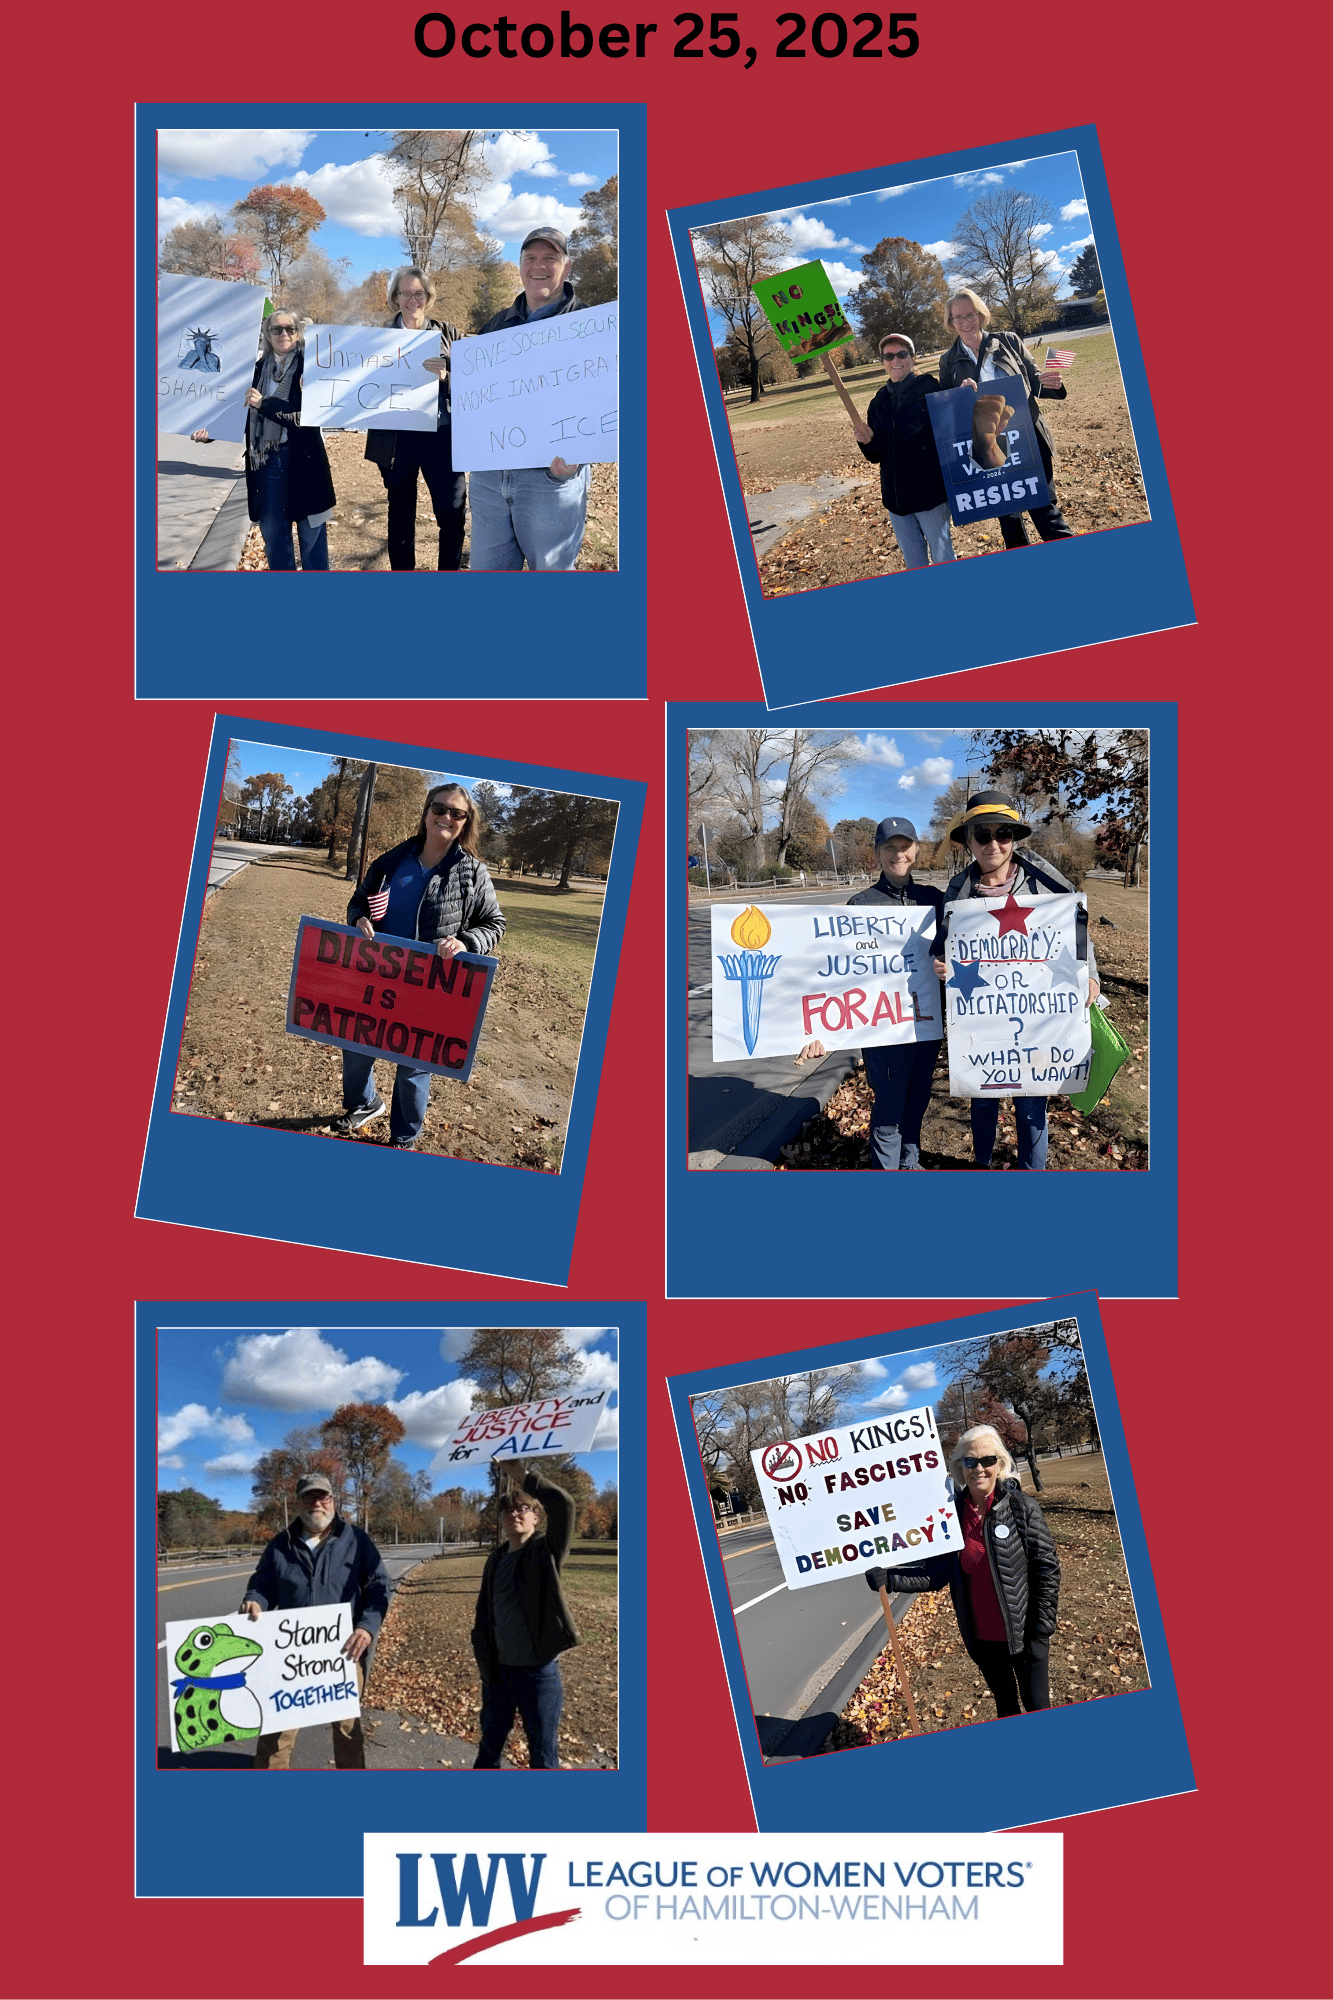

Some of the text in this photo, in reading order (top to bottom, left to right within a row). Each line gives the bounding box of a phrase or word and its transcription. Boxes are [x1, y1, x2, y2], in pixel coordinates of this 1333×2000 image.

[771, 284, 804, 309] NO
[775, 302, 842, 336] KINGS!
[463, 339, 507, 376] SAVE
[511, 326, 567, 356] SOCIAL
[319, 378, 412, 411] ICE
[457, 381, 502, 415] MORE
[490, 410, 618, 453] NO ICE
[955, 476, 1039, 513] RESIST
[813, 915, 907, 939] LIBERTY
[855, 937, 879, 951] and
[957, 930, 1056, 961] DEMOCRACY
[316, 928, 489, 998] DISSENT
[817, 953, 919, 977] JUSTICE
[362, 984, 397, 1010] IS
[994, 970, 1029, 991] OR
[802, 987, 934, 1035] FOR ALL
[956, 991, 1079, 1016] DICTATORSHIP
[293, 996, 468, 1070] PATRIOTIC
[1008, 1016, 1024, 1046] ?
[968, 1046, 1075, 1067] WHAT DO
[981, 1067, 1021, 1084] YOU
[452, 1409, 575, 1445] JUSTICE
[458, 1391, 606, 1430] LIBERTY and
[448, 1431, 563, 1462] for ALL
[804, 1407, 936, 1464] NO KINGS!
[777, 1450, 939, 1506] NO FASCISTS
[836, 1503, 897, 1532] SAVE
[275, 1613, 342, 1649] Stand
[281, 1653, 347, 1687] Strong
[269, 1681, 358, 1713] TOGETHER
